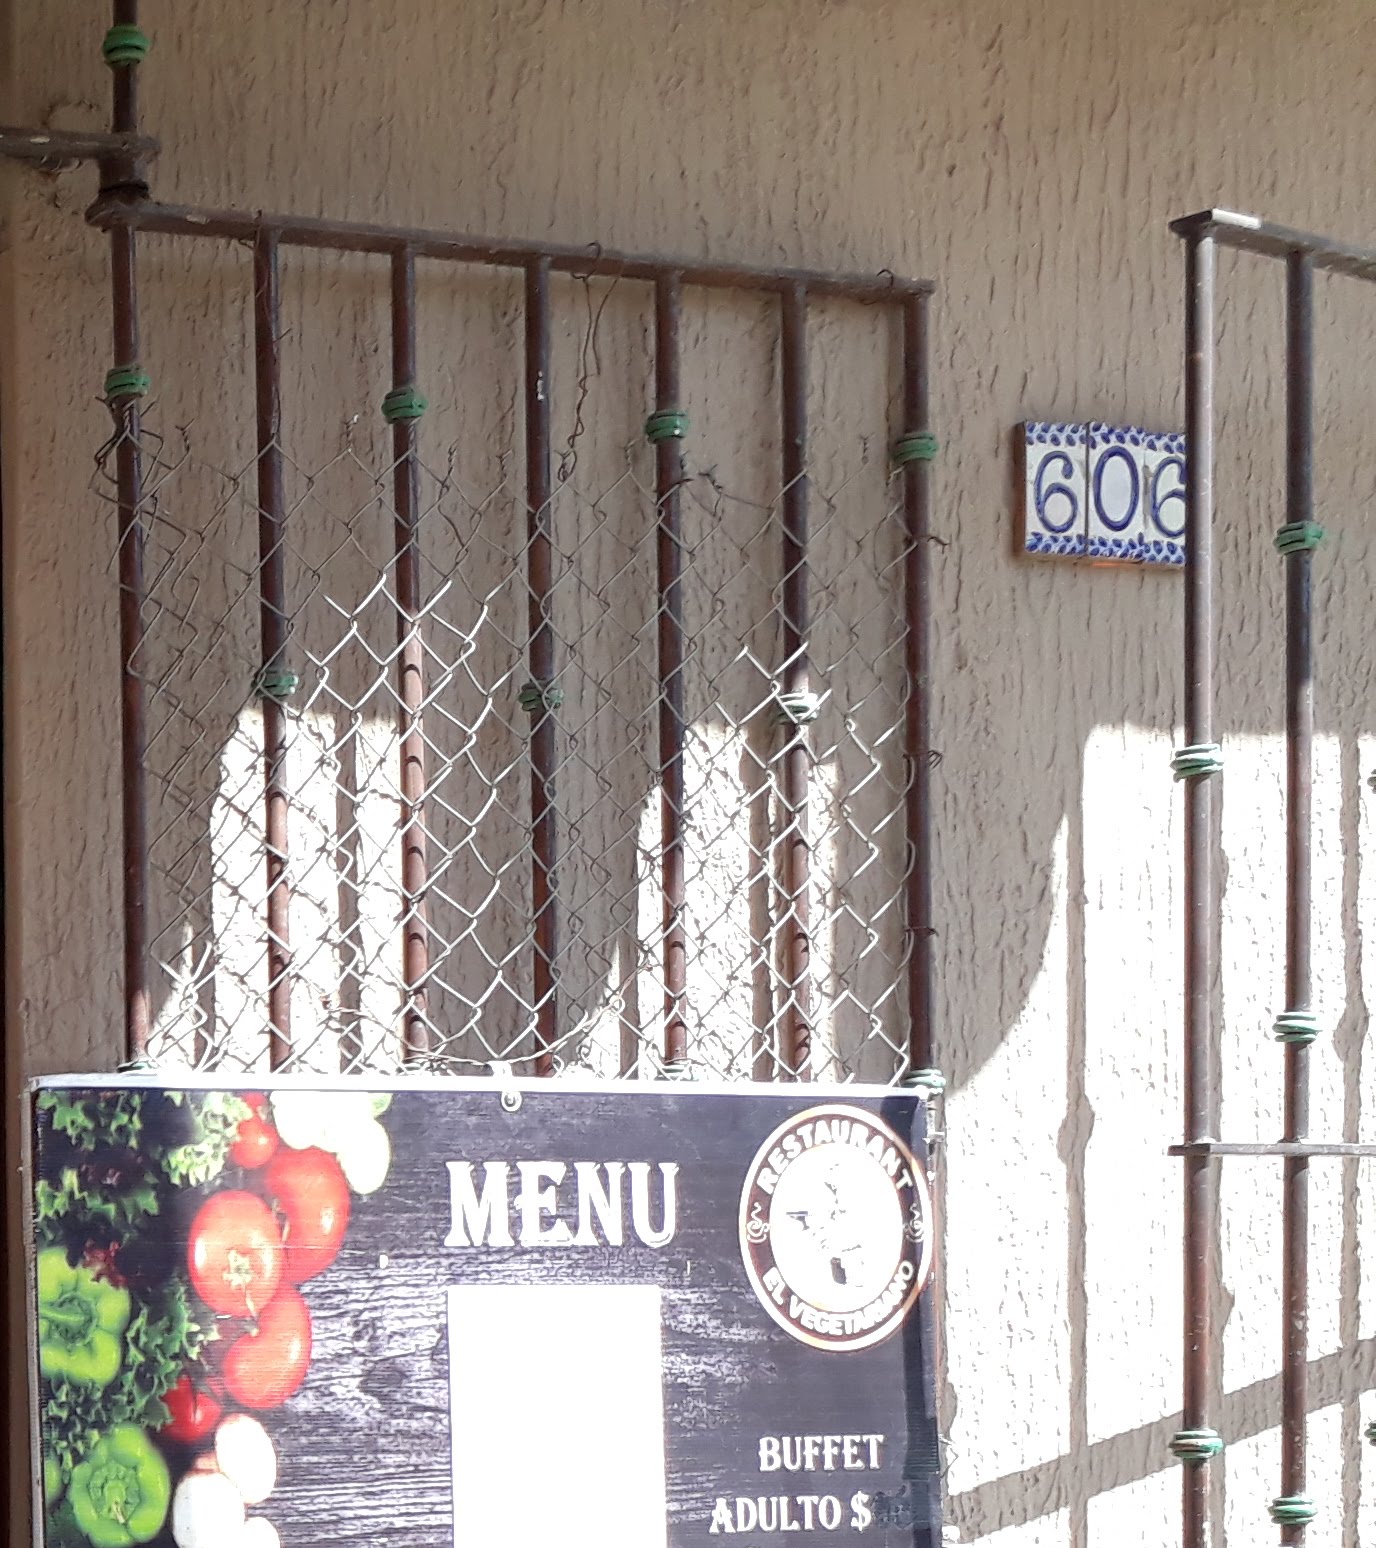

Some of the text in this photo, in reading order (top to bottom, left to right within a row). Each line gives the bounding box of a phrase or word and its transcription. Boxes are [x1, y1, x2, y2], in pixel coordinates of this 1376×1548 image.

[1034, 445, 1186, 539] 606
[756, 1118, 914, 1196] RESTAURANT
[443, 1160, 681, 1249] MENU
[762, 1260, 915, 1336] EL VEGETARIANO
[758, 1434, 885, 1473] BUFFET
[709, 1494, 842, 1534] ADULTO
